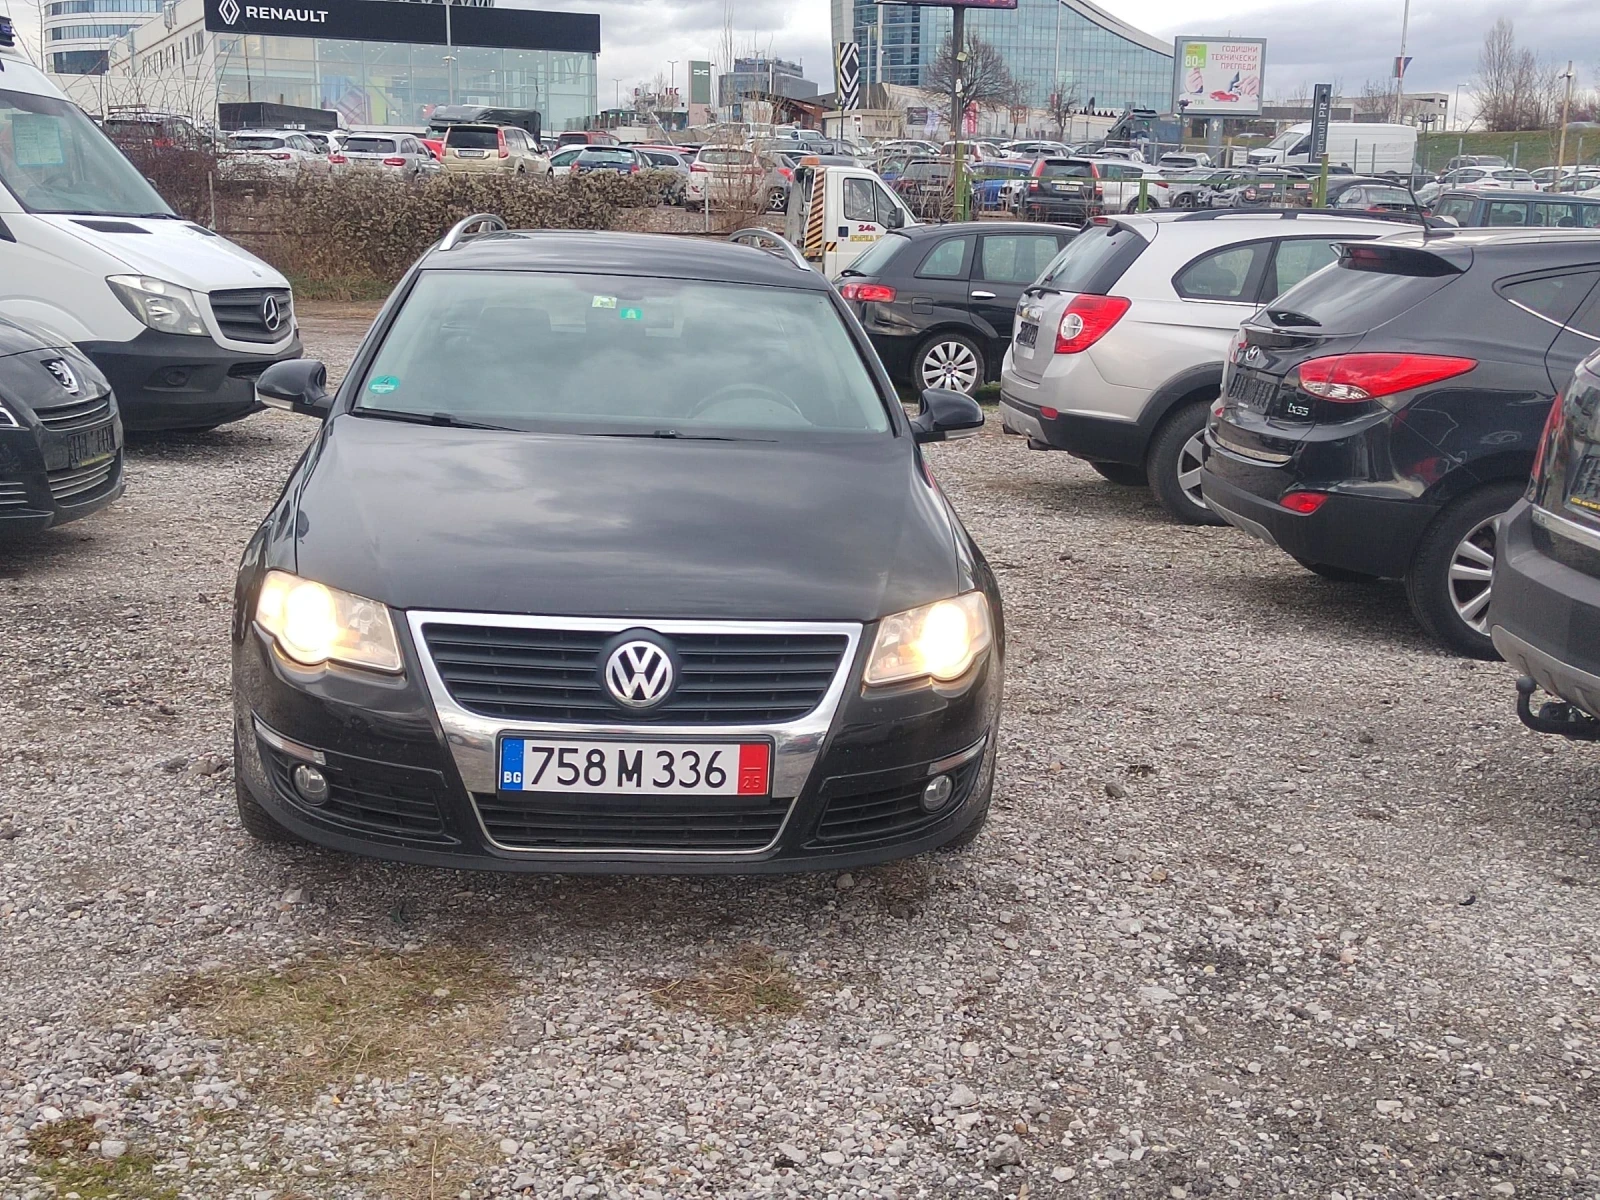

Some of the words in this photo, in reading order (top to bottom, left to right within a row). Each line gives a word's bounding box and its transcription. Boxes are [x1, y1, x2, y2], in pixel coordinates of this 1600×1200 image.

[245, 5, 329, 23] RENAULT
[1221, 45, 1258, 53] ГОДИШНИ
[1185, 55, 1198, 67] 80
[1211, 53, 1258, 62] ТЕХНИЧЕСКИ
[1220, 62, 1257, 71] ПРЕГЛЕДИ
[1314, 120, 1326, 159] Renault
[530, 746, 607, 787] 758
[617, 749, 643, 788] M
[652, 750, 727, 789] 336
[503, 770, 522, 784] BG
[743, 776, 761, 789] 25
